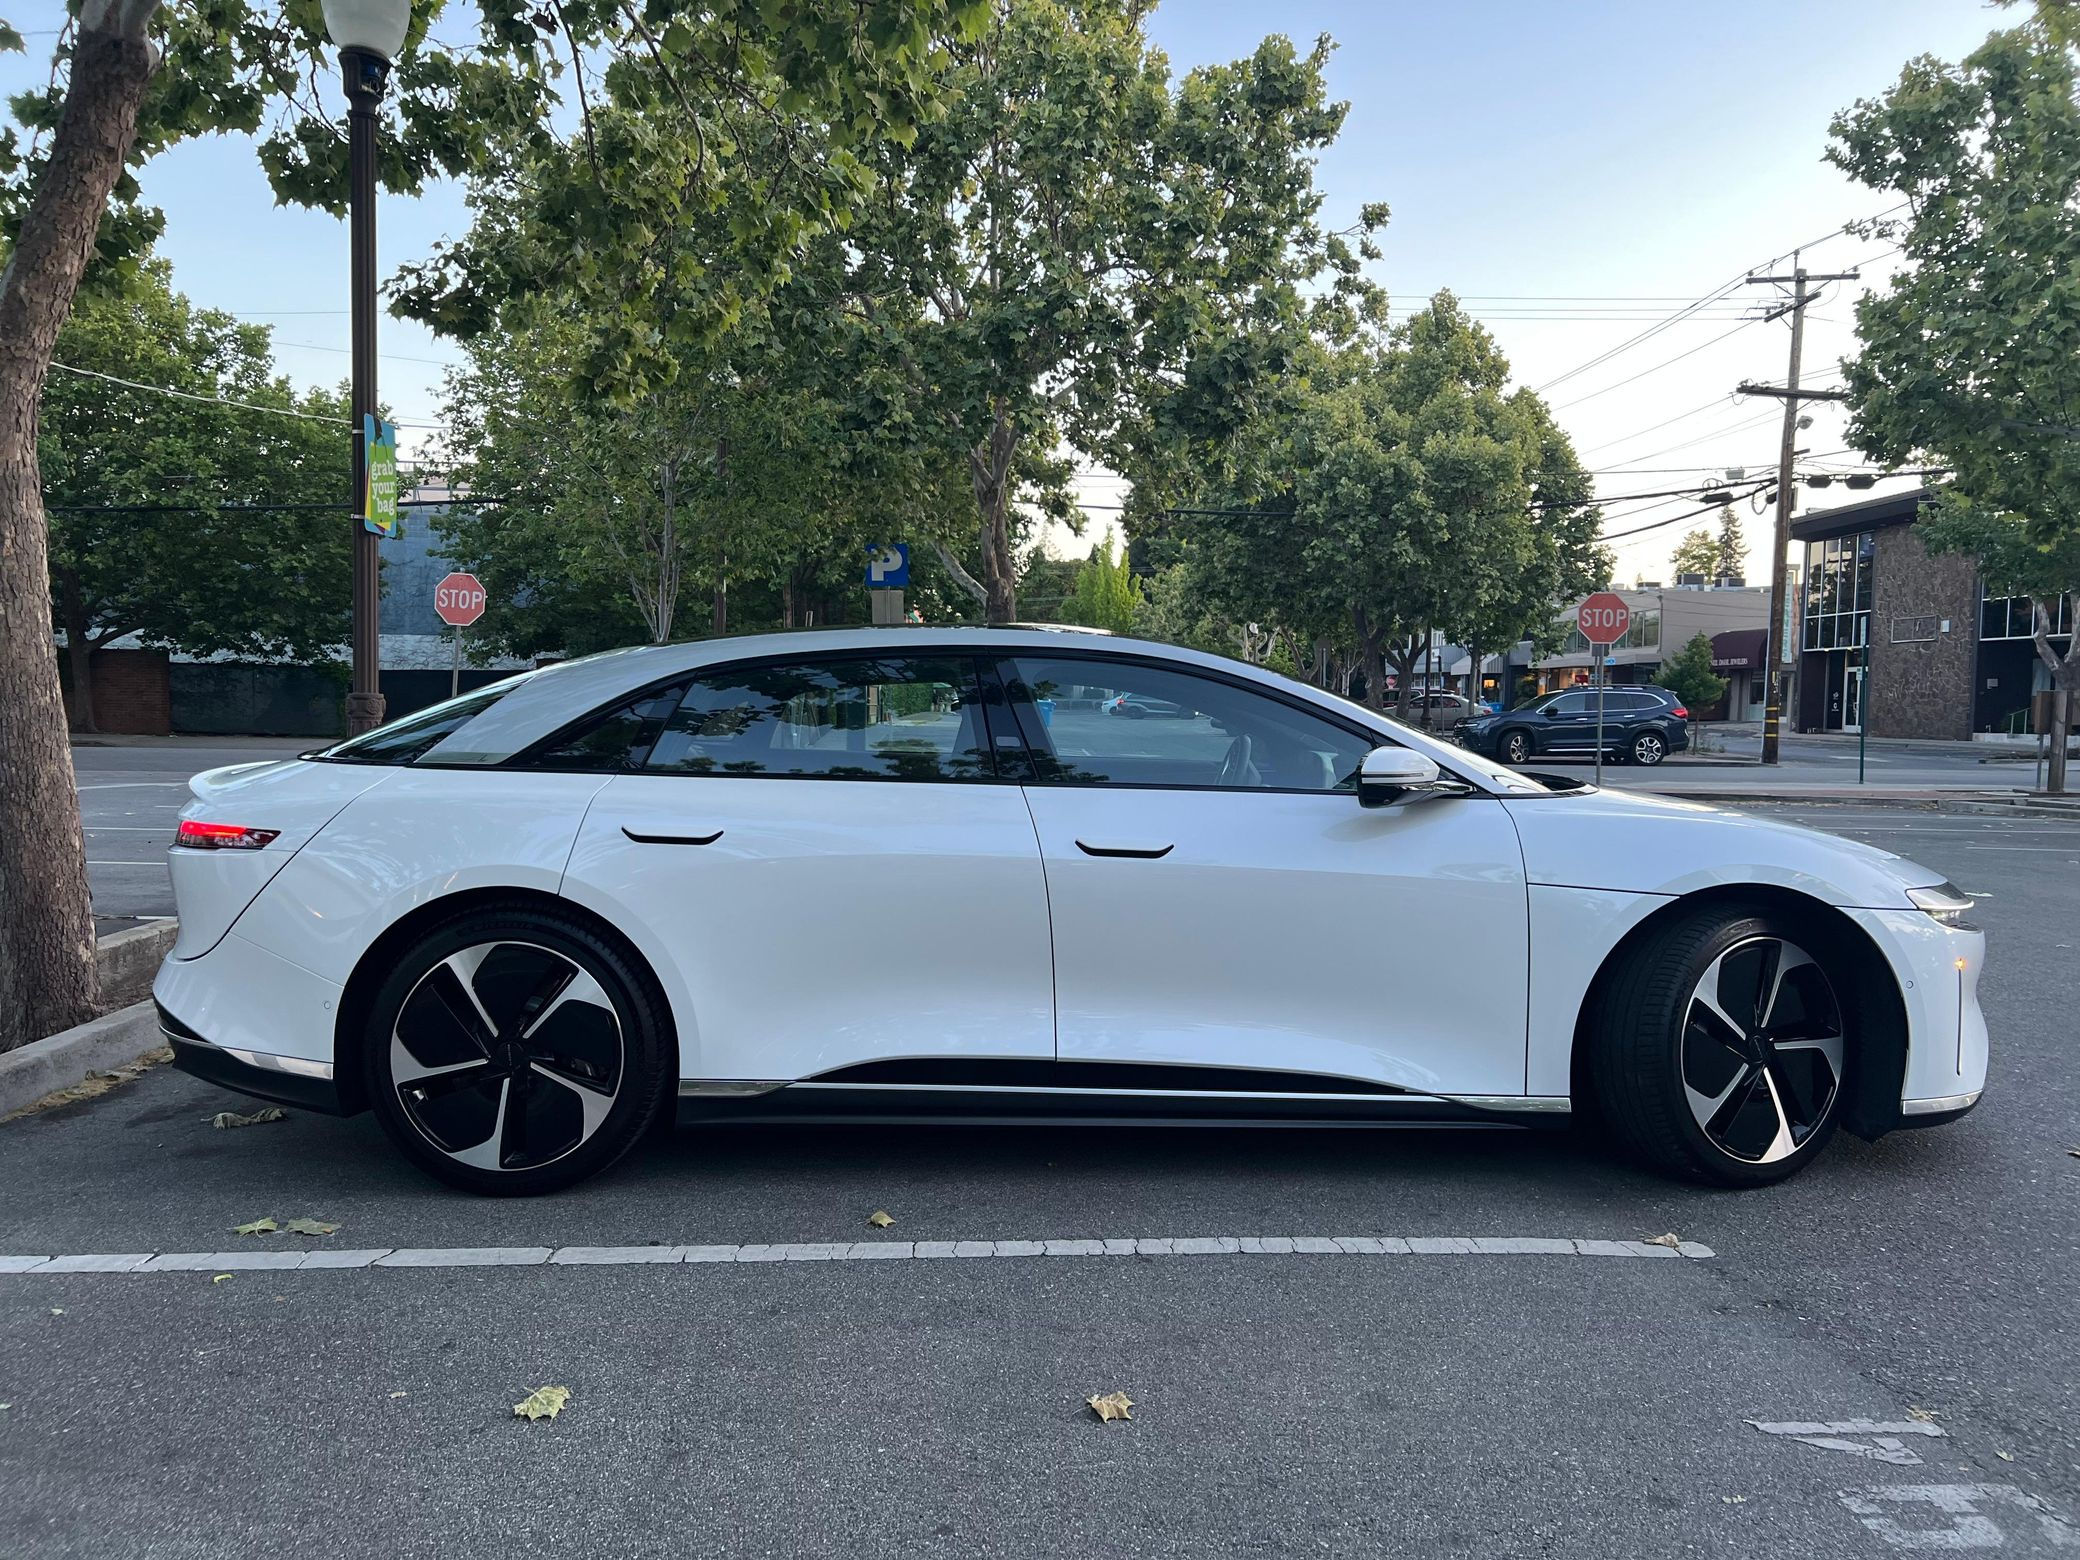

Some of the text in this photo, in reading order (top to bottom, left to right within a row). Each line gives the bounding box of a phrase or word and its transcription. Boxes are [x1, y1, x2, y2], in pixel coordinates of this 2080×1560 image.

[371, 460, 394, 480] grab
[371, 480, 395, 499] your
[376, 497, 395, 515] bag
[871, 546, 903, 581] P
[438, 588, 483, 610] STOP
[1581, 608, 1627, 628] STOP
